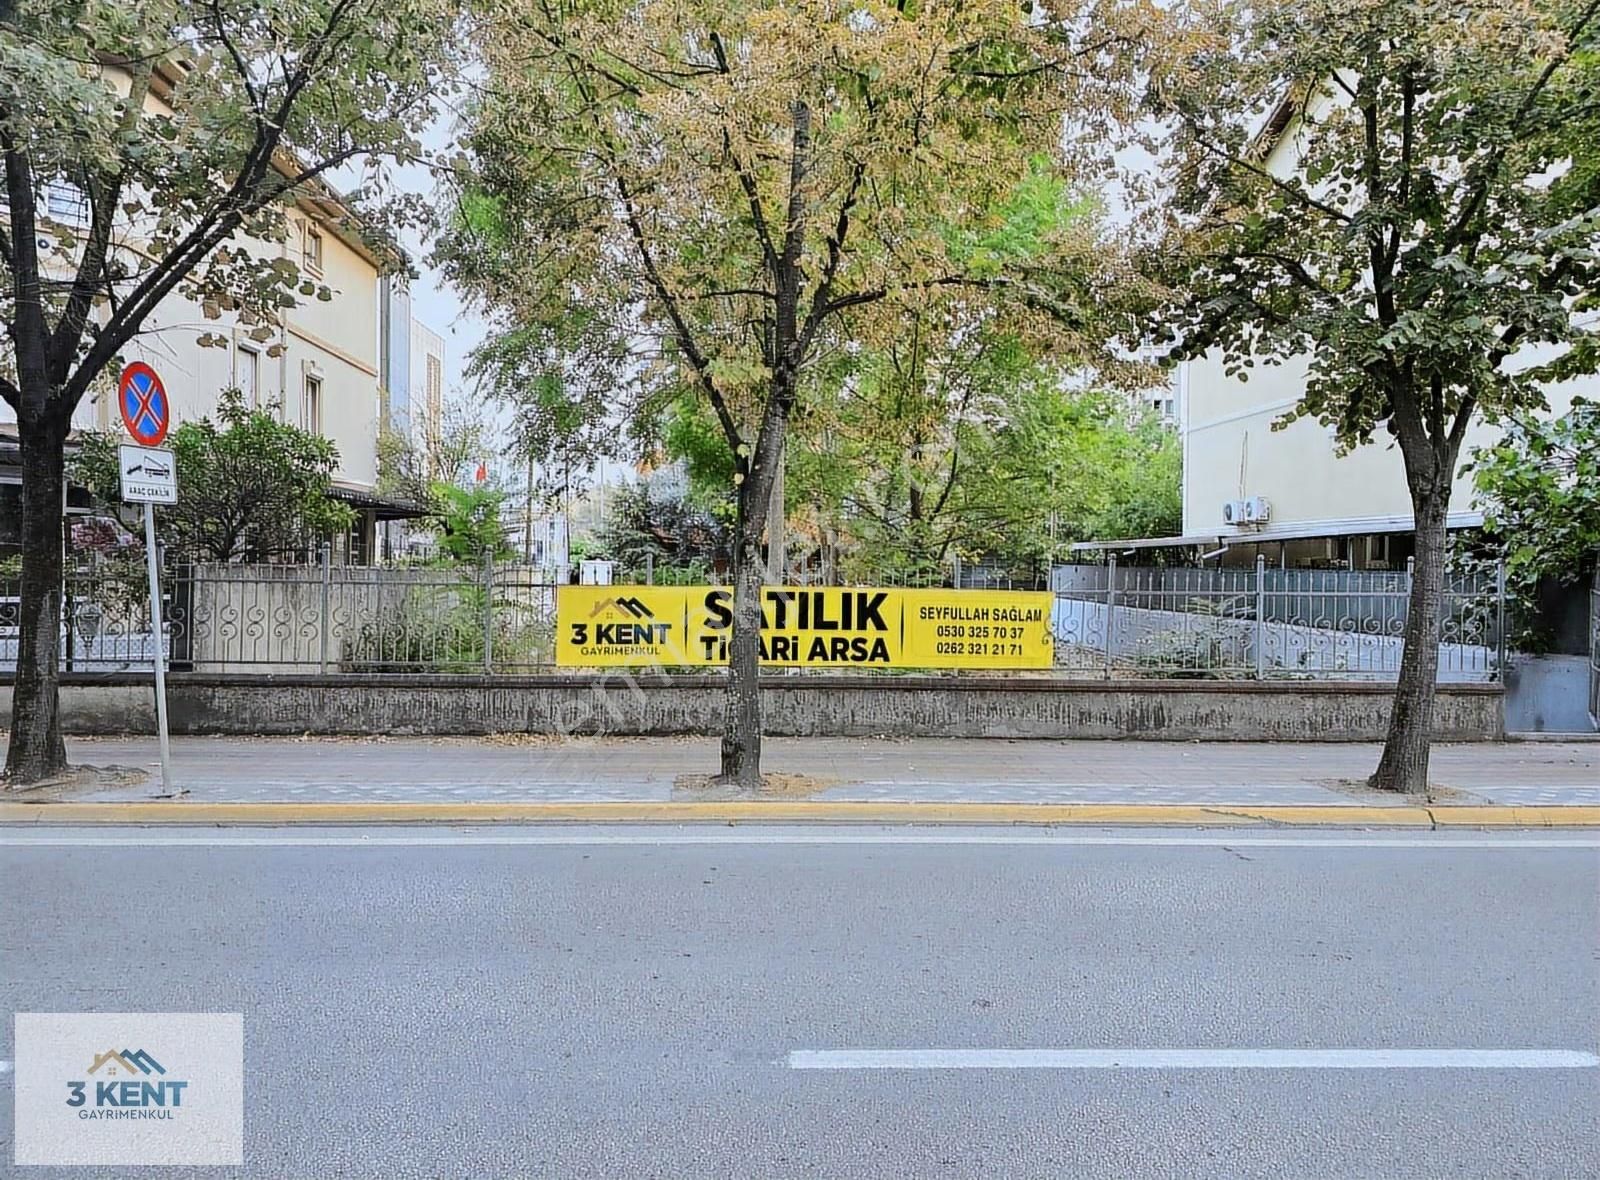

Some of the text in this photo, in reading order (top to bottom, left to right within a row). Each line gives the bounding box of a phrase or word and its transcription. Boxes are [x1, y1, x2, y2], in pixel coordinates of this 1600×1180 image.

[704, 590, 888, 631] STILIK
[920, 606, 1042, 622] SEYFULLAH SAĞLAM
[571, 624, 672, 645] 3 KENT
[937, 626, 1024, 639] 0530 325 70 37
[807, 637, 891, 662] ARSA
[937, 642, 1022, 655] 0262 321 21 71
